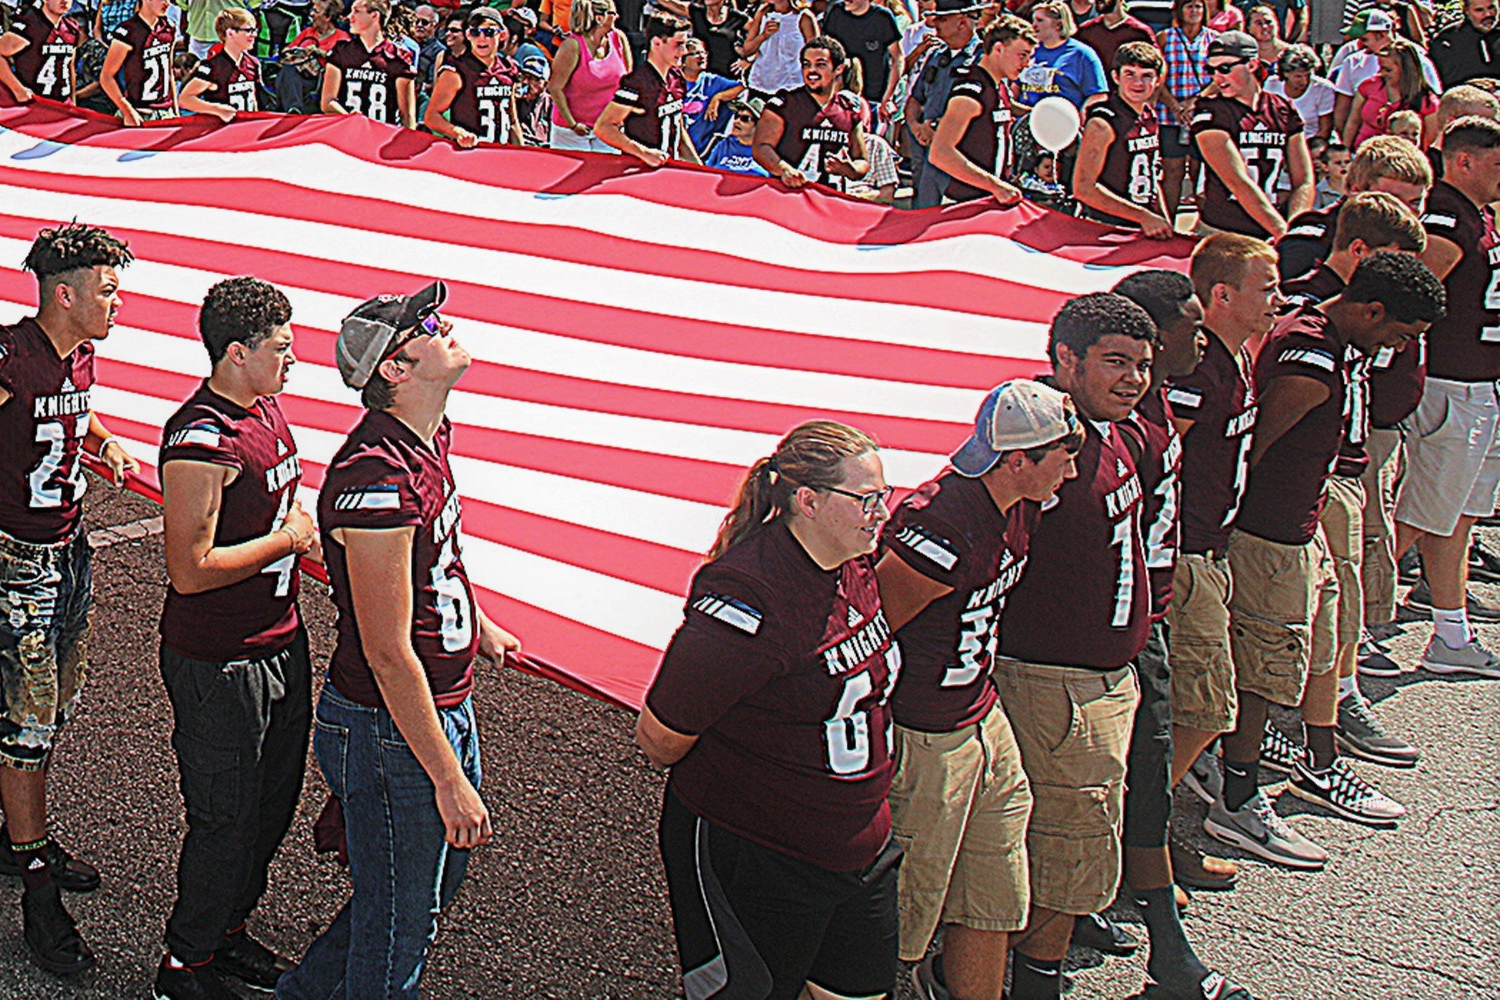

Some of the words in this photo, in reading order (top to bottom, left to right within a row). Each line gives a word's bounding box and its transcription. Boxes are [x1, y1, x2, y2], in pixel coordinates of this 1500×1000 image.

[140, 53, 171, 102] 21
[345, 66, 388, 83] KNIGHTS
[344, 81, 389, 124] 58
[802, 127, 850, 144] KNIGHTS
[1239, 130, 1287, 147] KNIGHTS
[33, 390, 92, 419] KNIGHTS
[1105, 473, 1143, 519] KNIGHT
[966, 555, 1028, 609] KNIGHT
